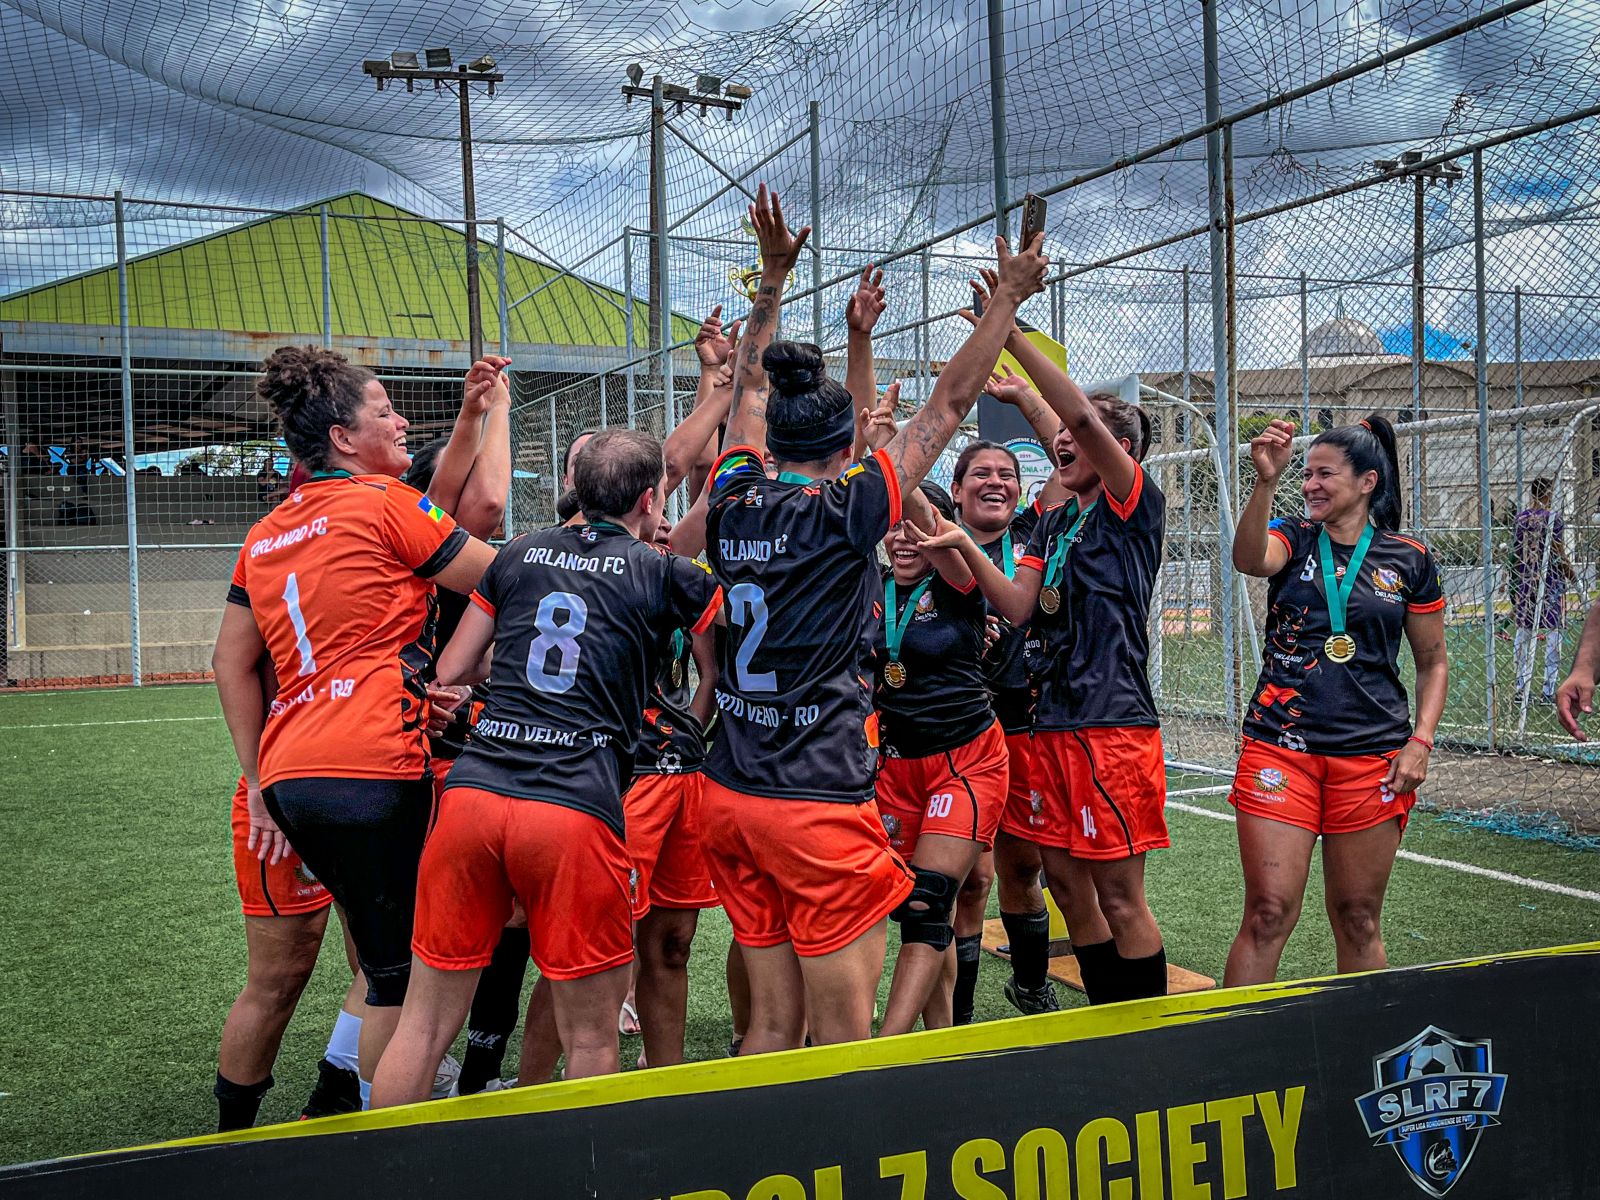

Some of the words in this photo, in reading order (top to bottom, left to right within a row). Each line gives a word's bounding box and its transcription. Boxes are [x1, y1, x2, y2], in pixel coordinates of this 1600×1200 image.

[1020, 464, 1039, 473] ÔNIA
[250, 525, 309, 558] ORLANDO
[308, 516, 328, 538] FC
[523, 547, 599, 573] ORLANDO
[602, 556, 626, 575] FC
[1374, 590, 1403, 602] ORLANDO
[281, 571, 317, 677] 1
[727, 582, 778, 692] 2
[526, 591, 588, 694] 8
[1273, 652, 1303, 663] ORLANDO
[1281, 660, 1291, 669] FC
[794, 704, 820, 727] RO
[927, 793, 953, 818] 80
[1080, 805, 1098, 839] 14
[1378, 1080, 1492, 1124] SLRF7
[1401, 1124, 1416, 1133] SUPER
[1415, 1122, 1426, 1131] LIGA
[1455, 1116, 1462, 1124] DE
[951, 1086, 1305, 1200] SOCIETY
